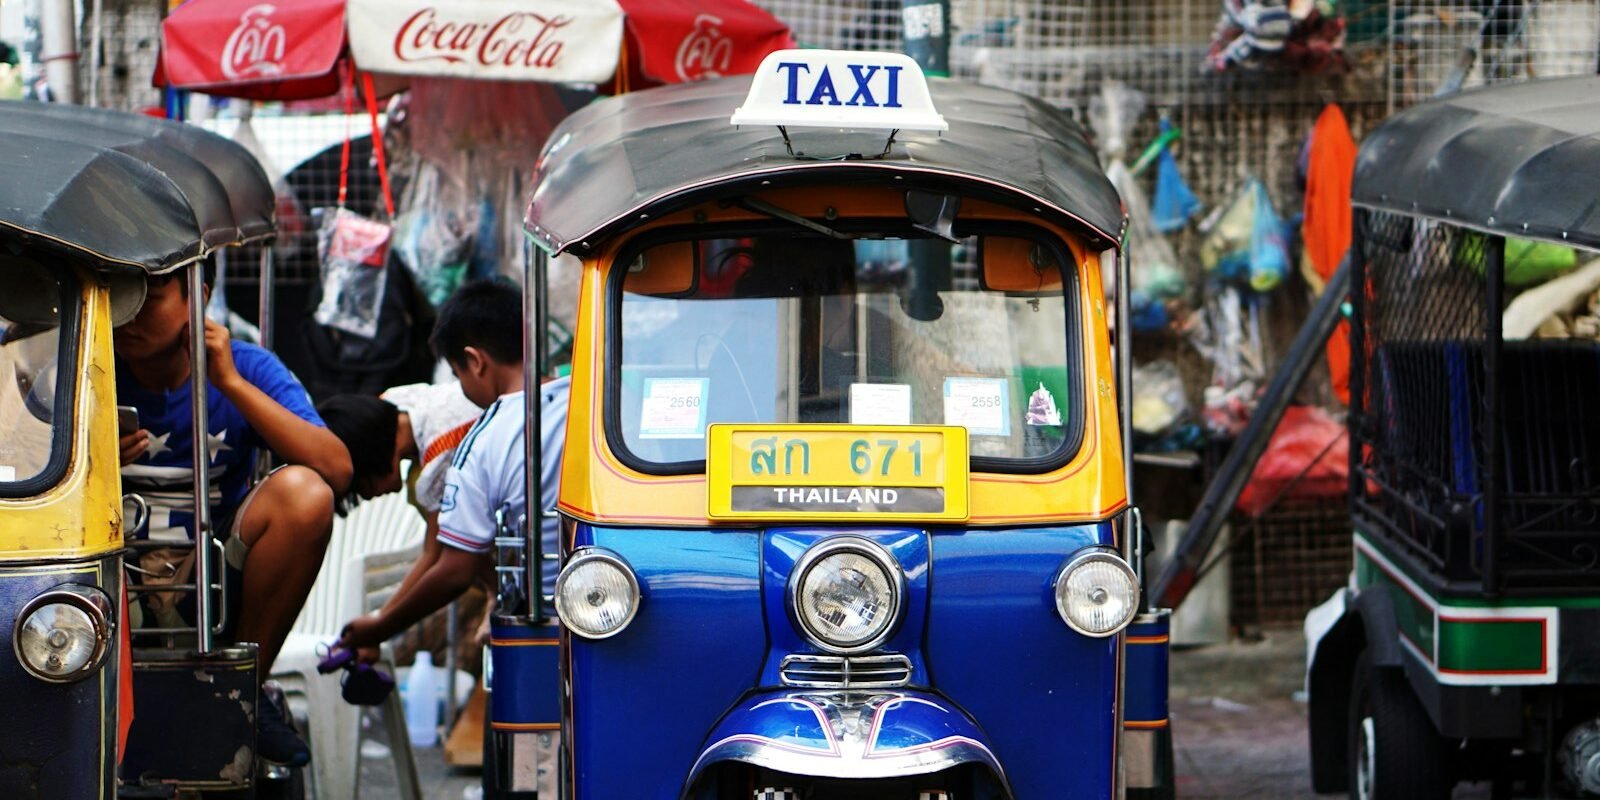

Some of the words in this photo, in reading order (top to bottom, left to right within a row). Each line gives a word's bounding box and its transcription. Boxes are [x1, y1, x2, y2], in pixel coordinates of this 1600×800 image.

[393, 7, 575, 69] Coca-Cola
[776, 62, 903, 108] TAXI
[670, 396, 701, 408] 2560
[971, 395, 1001, 408] 2558
[750, 436, 810, 475] สก
[850, 439, 922, 476] 671
[773, 487, 898, 505] THAILAND
